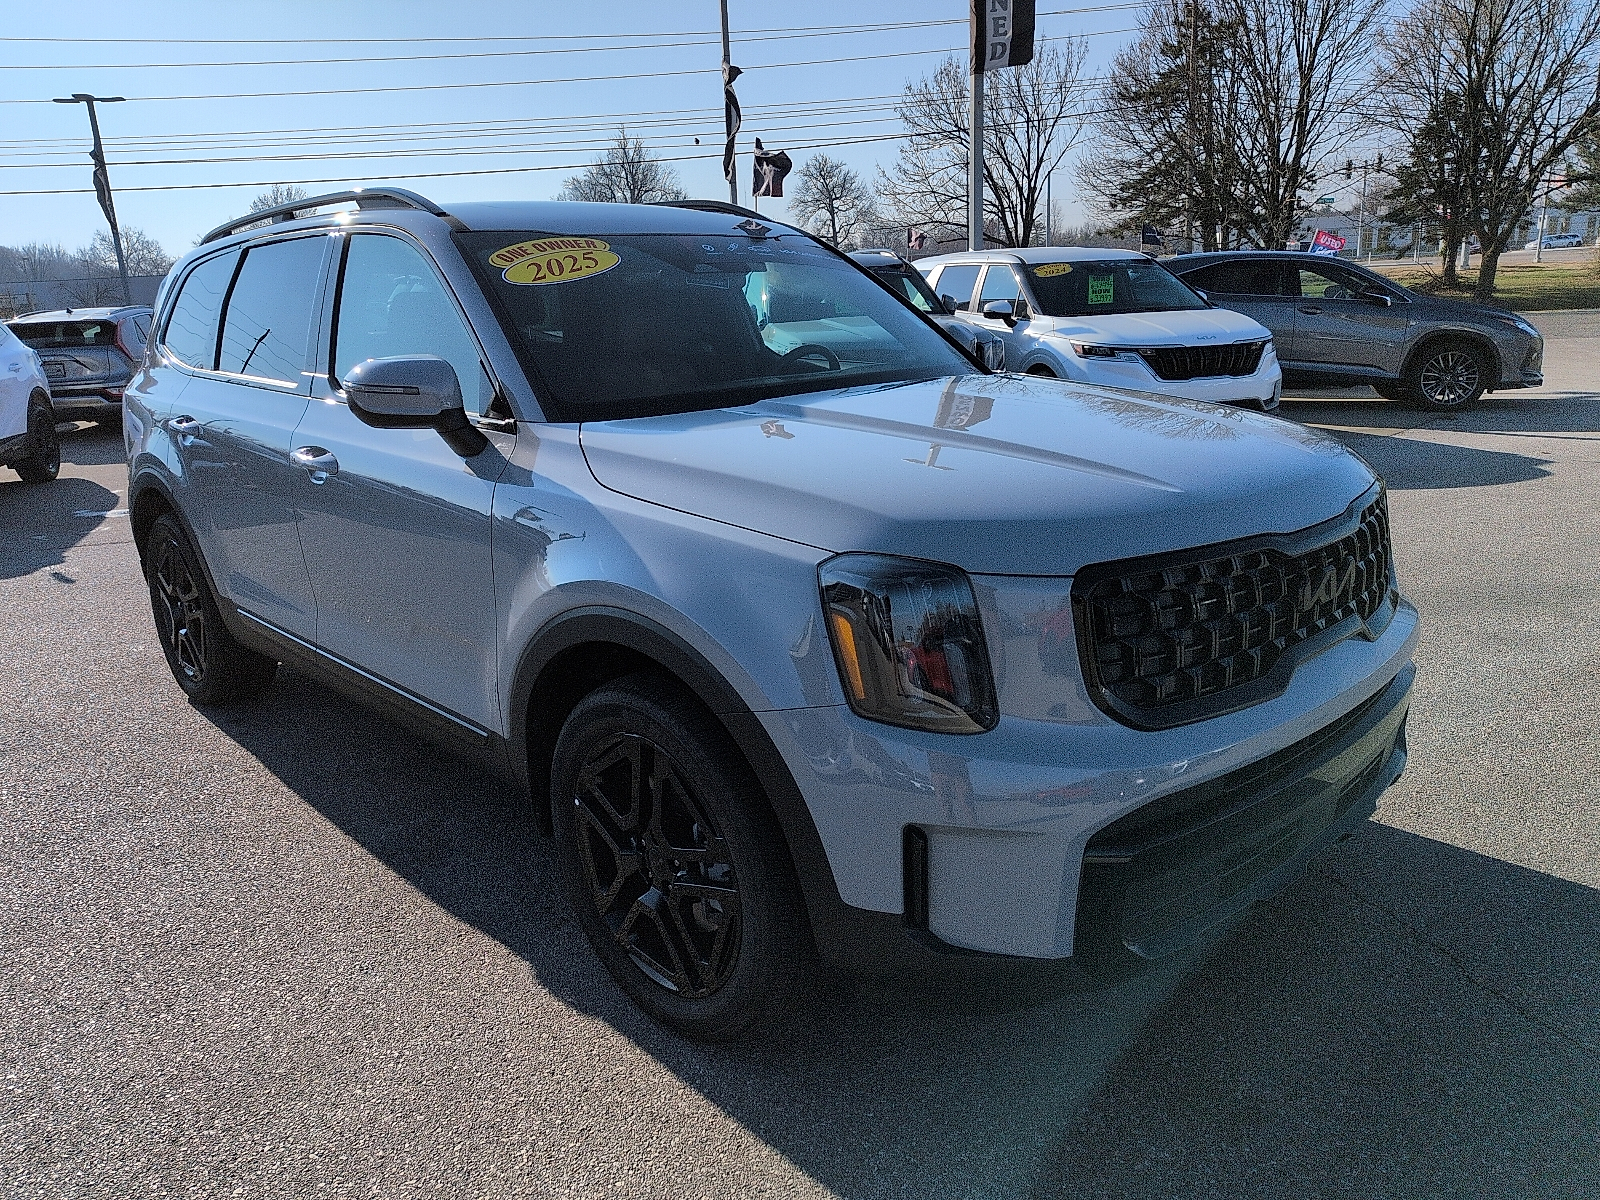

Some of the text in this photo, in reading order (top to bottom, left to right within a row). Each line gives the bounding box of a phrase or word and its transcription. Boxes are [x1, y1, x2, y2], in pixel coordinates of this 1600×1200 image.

[495, 239, 598, 263] ONE OWNER
[1320, 234, 1341, 249] USED
[526, 251, 599, 282] 2025
[1043, 267, 1066, 276] 2024
